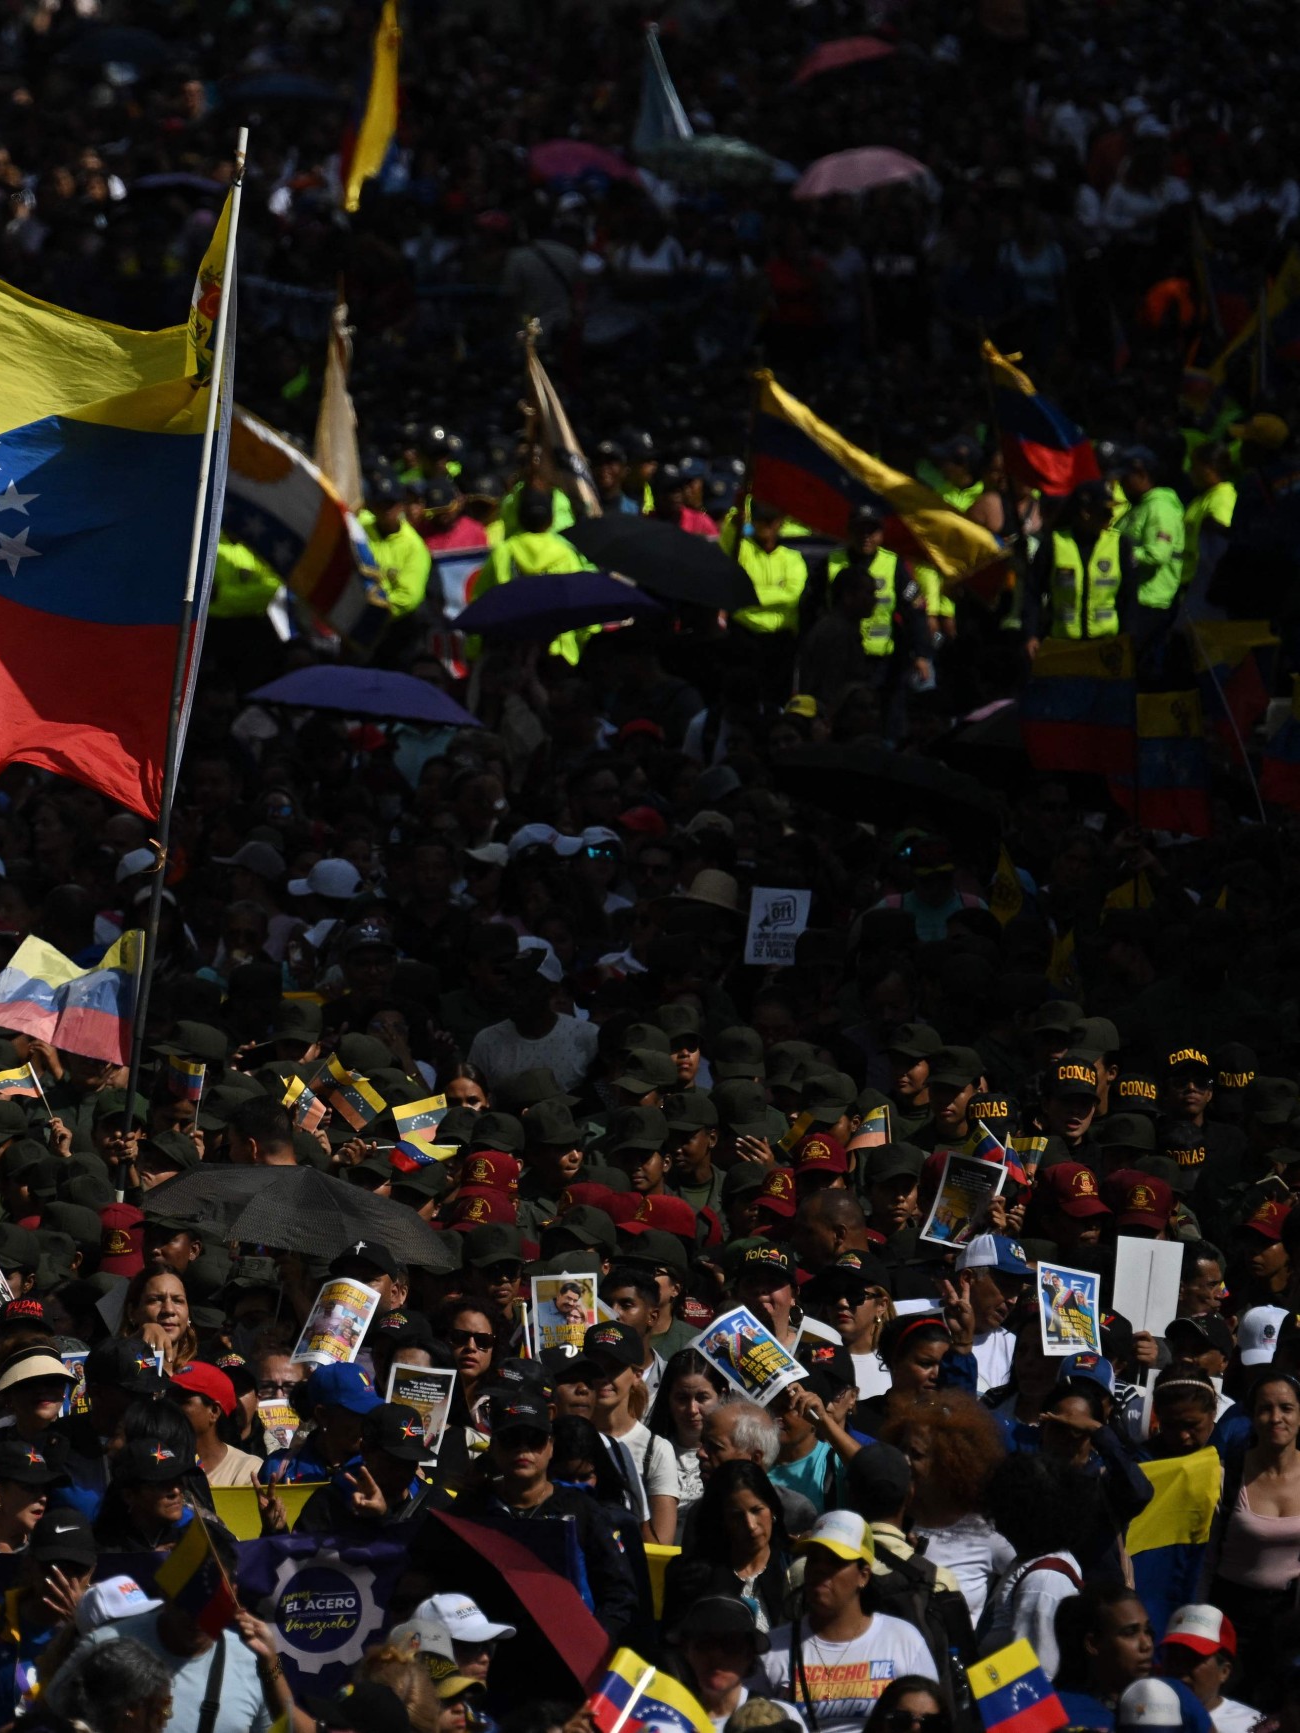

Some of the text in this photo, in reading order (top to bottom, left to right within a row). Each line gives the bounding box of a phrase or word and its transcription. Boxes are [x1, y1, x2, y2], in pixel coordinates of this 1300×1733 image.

[1168, 1047, 1210, 1067] CONAS
[1057, 1063, 1097, 1087] CONAS
[1218, 1070, 1256, 1089] CONAS
[1119, 1079, 1157, 1100] CONAS
[969, 1099, 1009, 1119] CONAS
[77, 1397, 87, 1407] EL
[77, 1406, 89, 1414] LOS
[258, 1408, 269, 1419] EL
[285, 1597, 356, 1614] EL ACERO
[285, 1615, 356, 1640] Venezuela
[870, 1660, 894, 1680] ME
